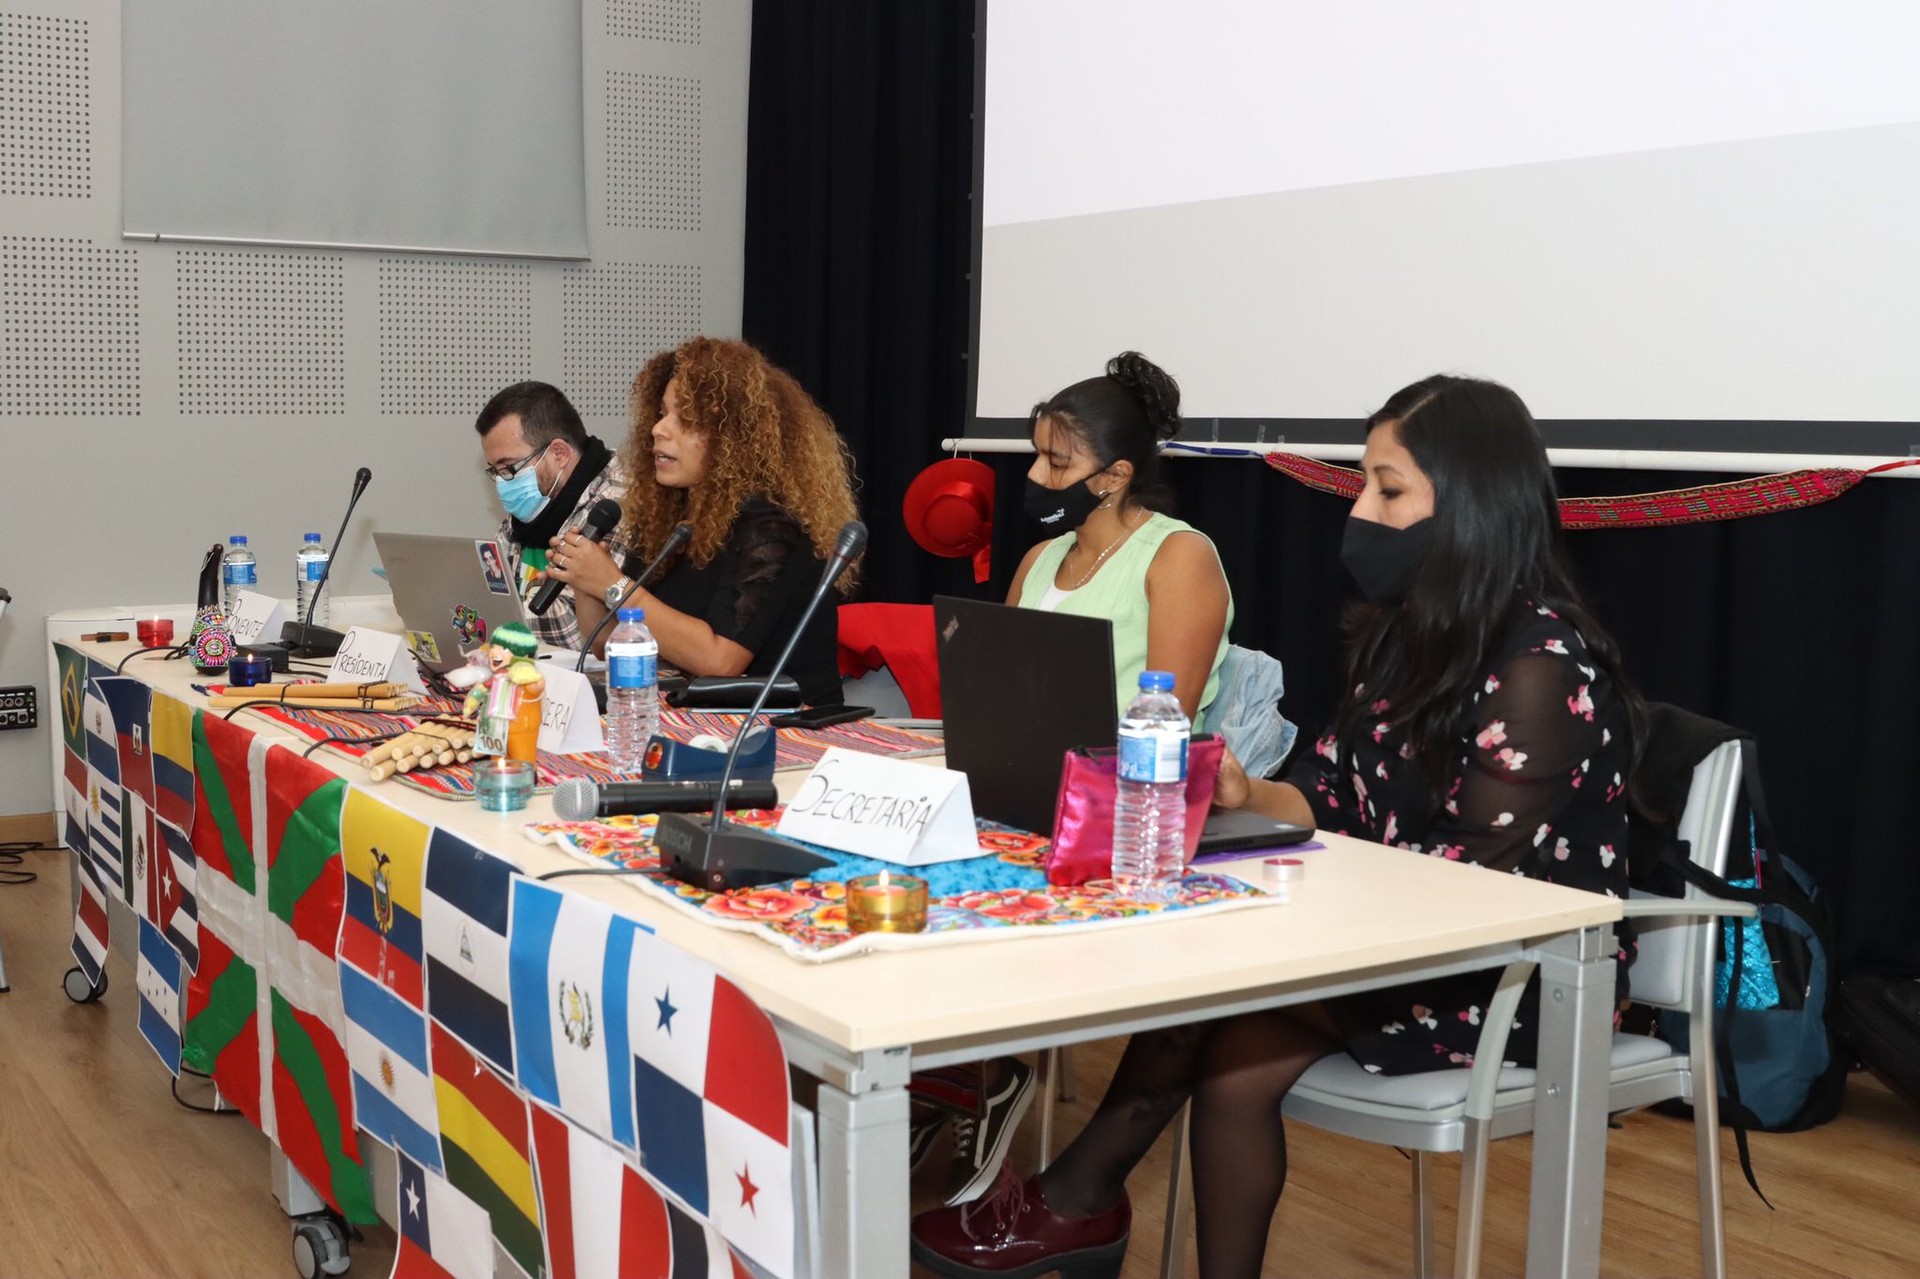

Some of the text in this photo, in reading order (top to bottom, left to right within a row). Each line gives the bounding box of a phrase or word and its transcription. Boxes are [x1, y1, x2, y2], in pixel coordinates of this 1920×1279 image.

[543, 697, 570, 734] ERA
[480, 734, 503, 752] 100
[791, 759, 932, 836] SECRETARIA
